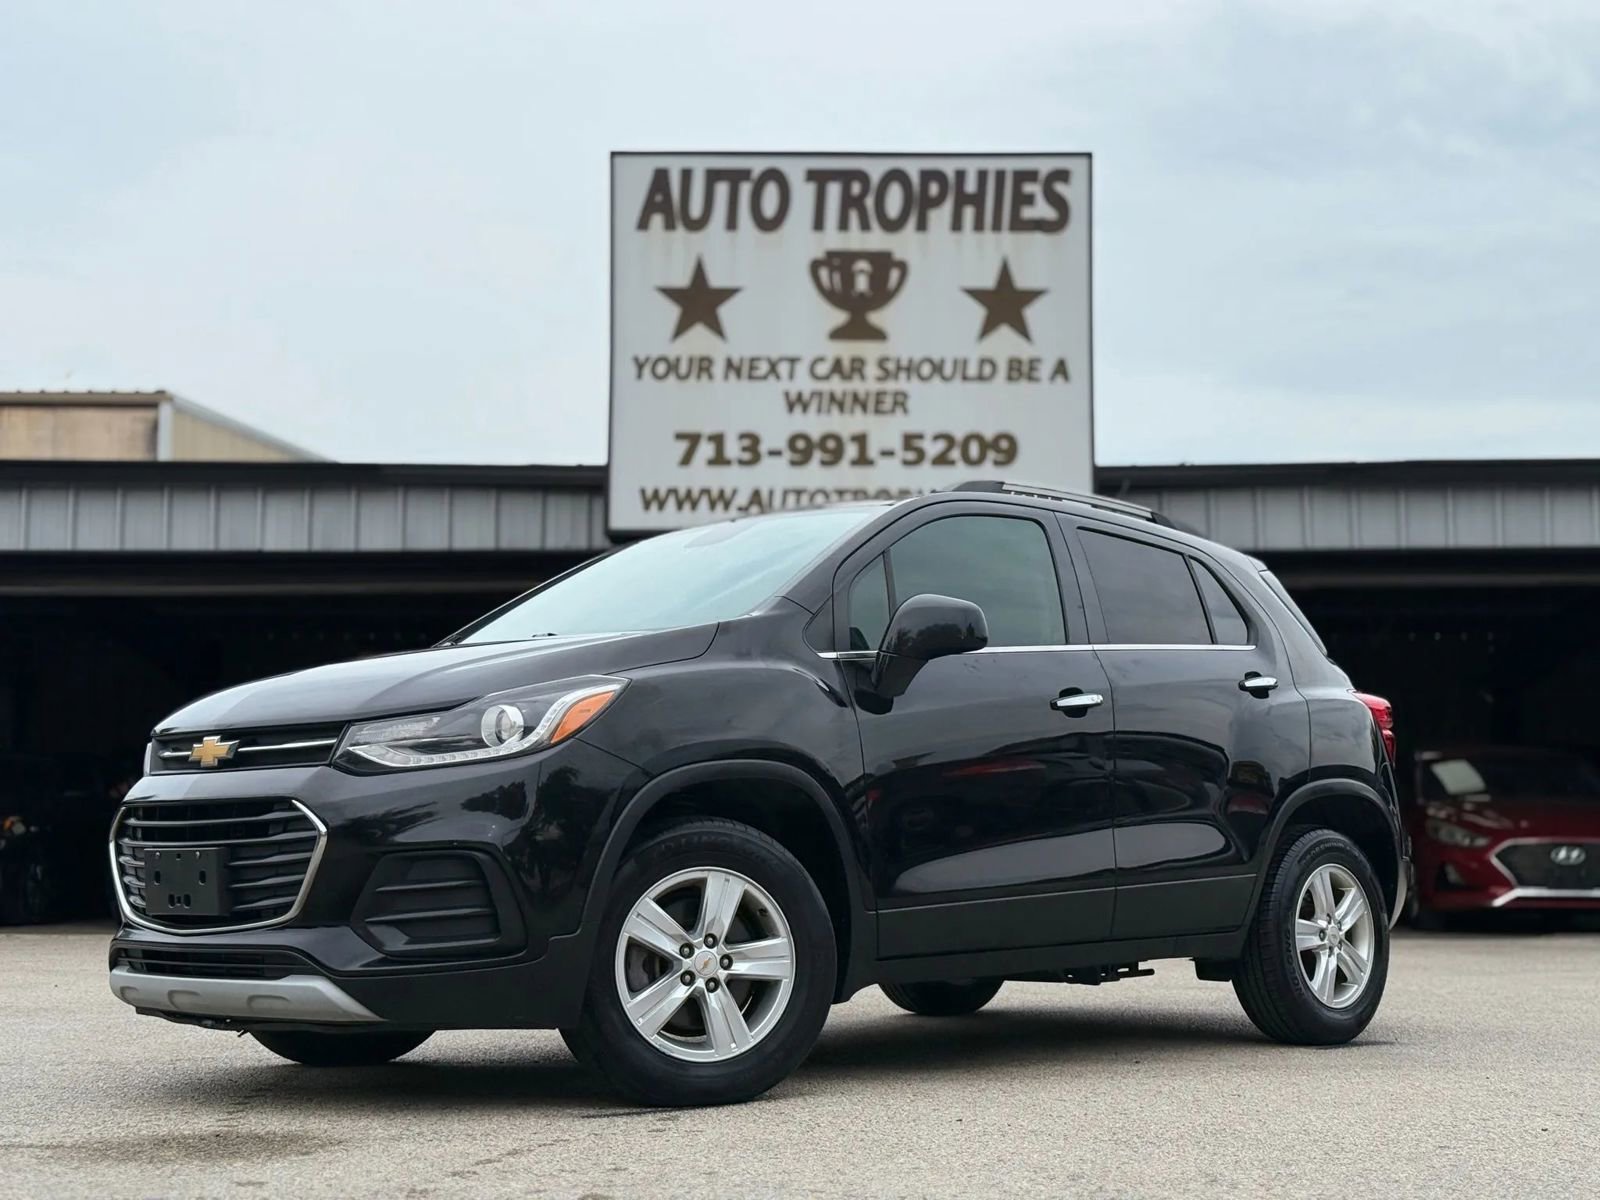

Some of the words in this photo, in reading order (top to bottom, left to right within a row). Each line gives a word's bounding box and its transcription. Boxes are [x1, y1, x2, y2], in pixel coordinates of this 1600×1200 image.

[636, 167, 791, 233] AUTO
[804, 167, 1072, 235] TROPHIES
[632, 355, 714, 382] YOUR
[723, 355, 801, 382] NEXT
[808, 355, 866, 382] CAR
[875, 355, 997, 383] SHOULD
[1005, 356, 1041, 382] BE
[1050, 357, 1070, 382] A
[783, 390, 909, 415] WINNER
[674, 431, 1018, 467] 713-991-5209
